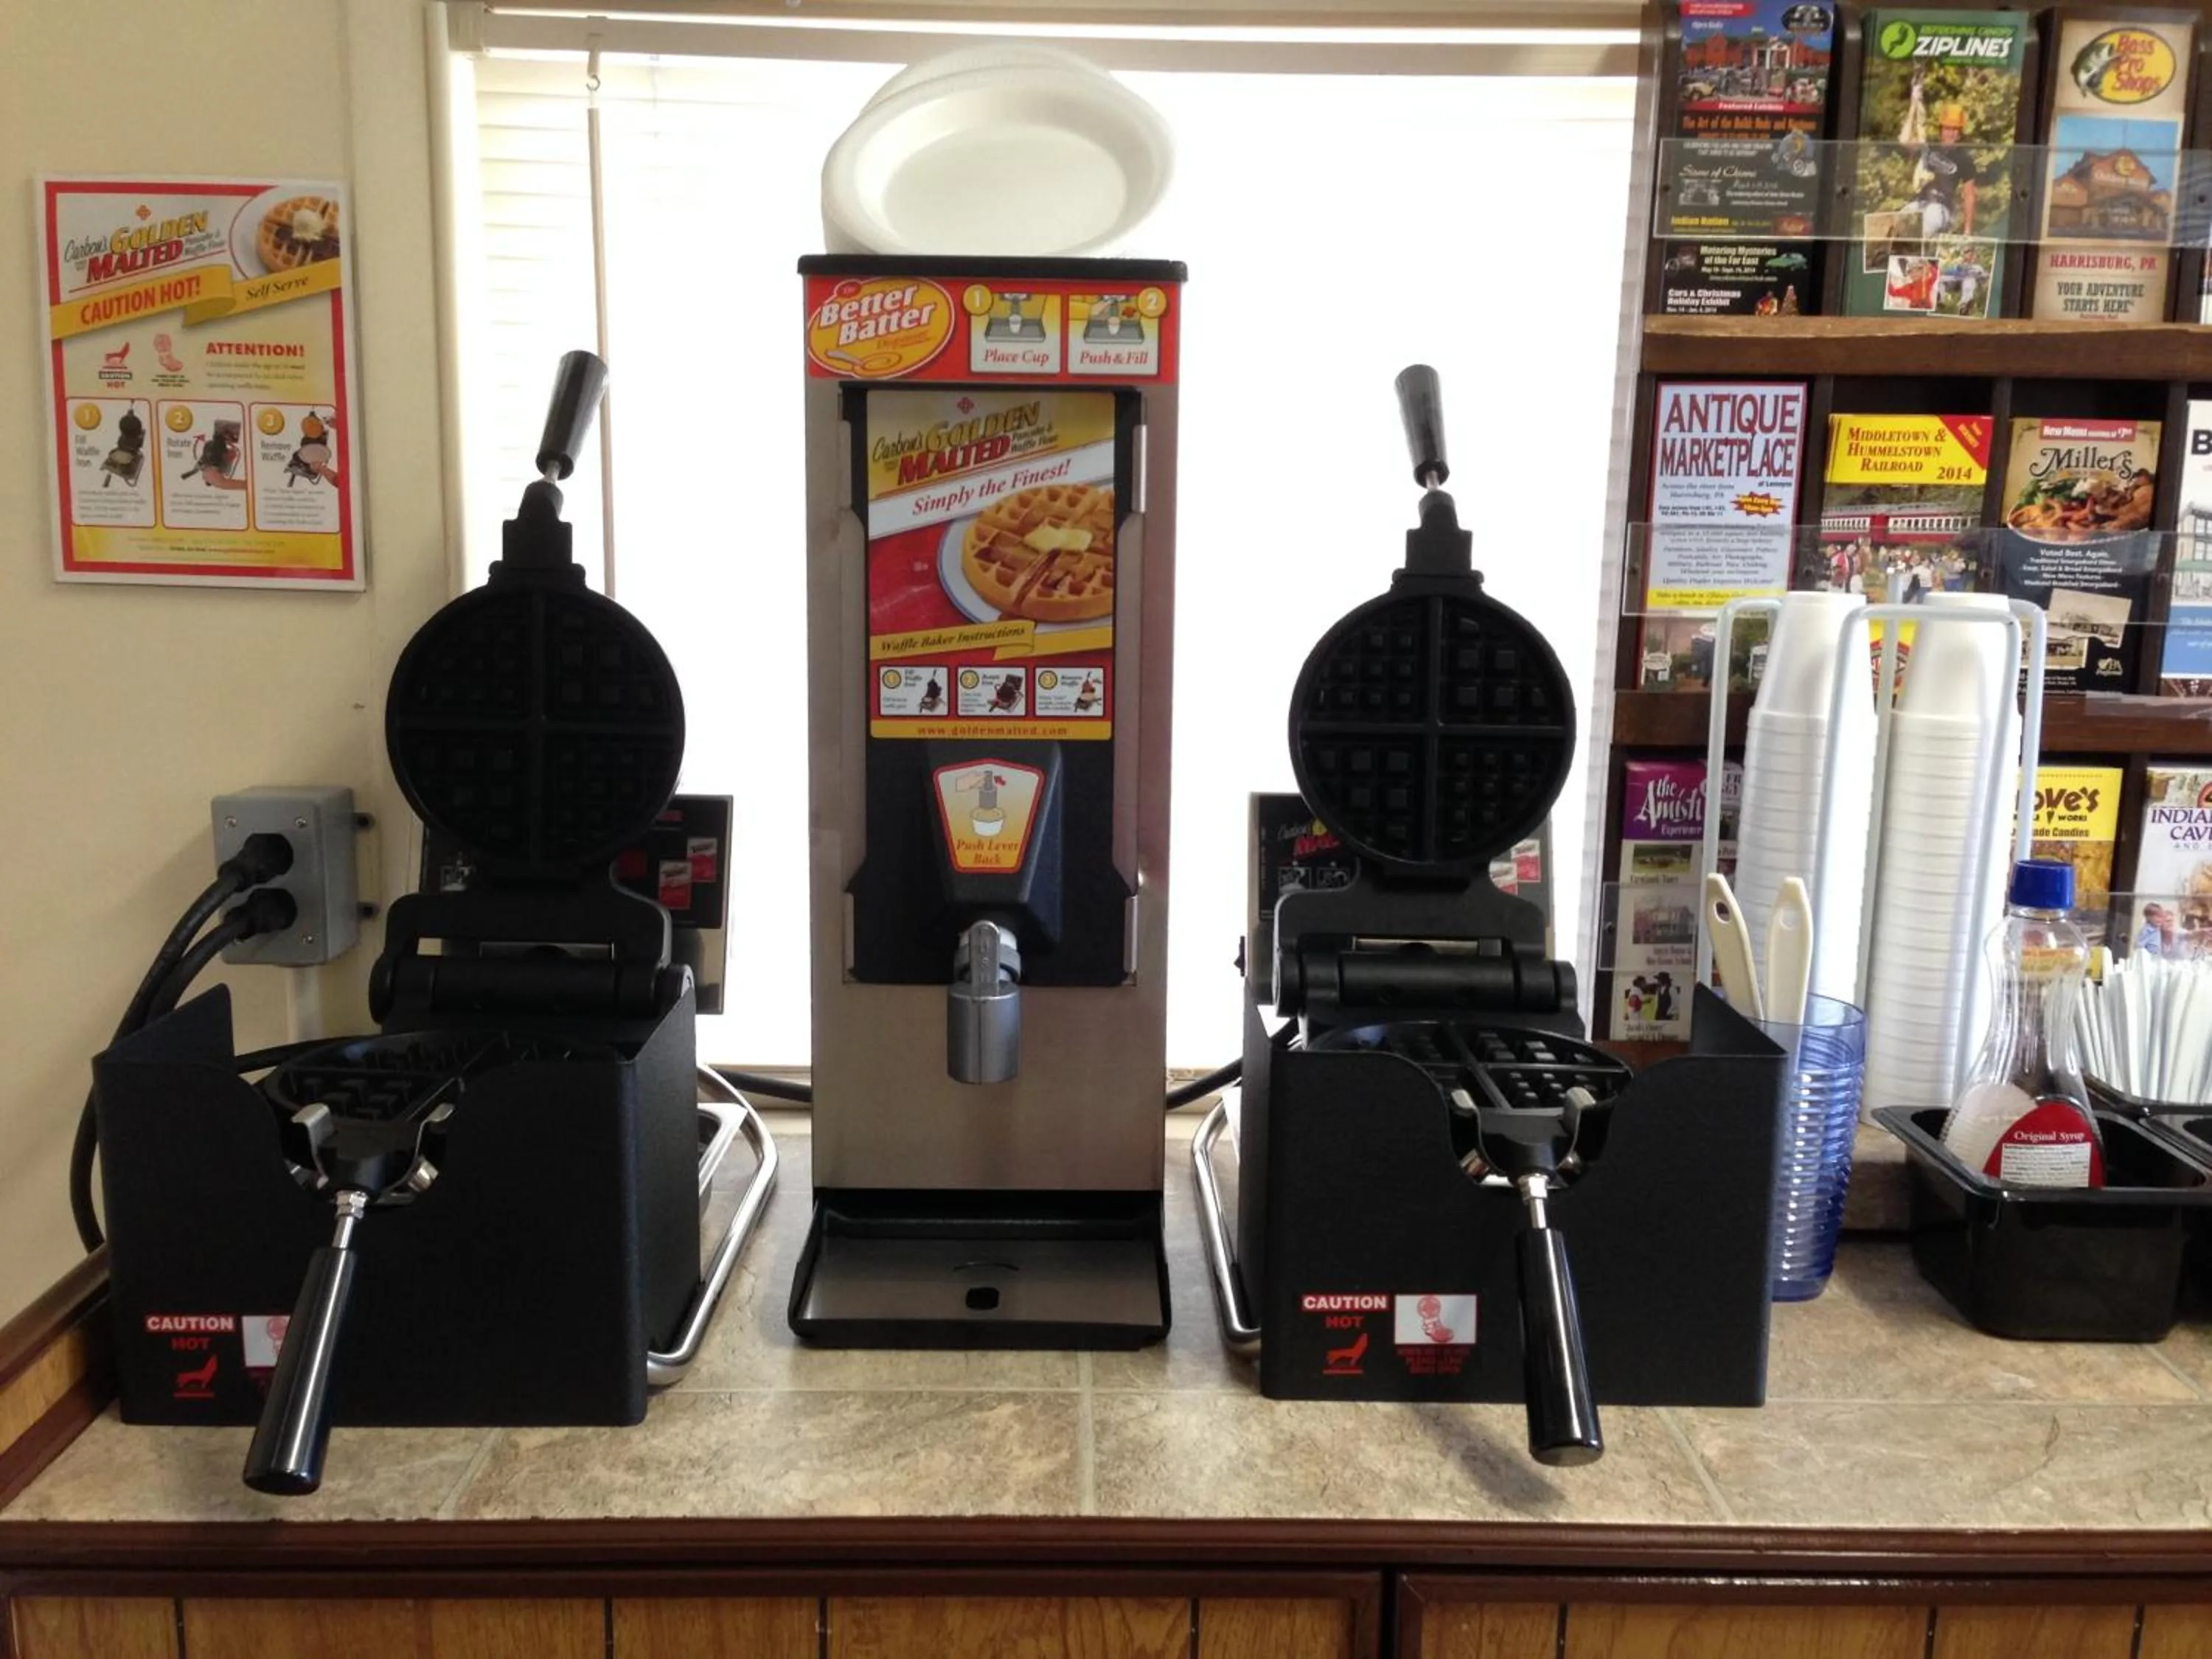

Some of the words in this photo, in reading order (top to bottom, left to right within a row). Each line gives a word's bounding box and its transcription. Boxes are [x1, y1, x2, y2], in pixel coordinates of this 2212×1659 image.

[1913, 35, 2013, 58] ZIPLINES
[2117, 35, 2154, 55] Bass
[2115, 52, 2145, 72] Pro
[2112, 73, 2162, 95] Shops
[110, 210, 209, 254] GOLDEN
[86, 239, 184, 283] MALTED
[2050, 254, 2136, 271] HARRISBURG,
[2140, 257, 2157, 270] PA
[273, 276, 309, 294] Serve
[1668, 288, 1688, 296] Cars
[1697, 288, 1741, 298] Christmas
[2057, 282, 2083, 296] YOUR
[2087, 282, 2145, 297] ADVENTURE
[80, 286, 156, 325] CAUTION
[160, 275, 201, 303] HOT!
[973, 288, 982, 308] 1
[1148, 293, 1158, 310] 2
[2063, 298, 2099, 312] STARTS
[819, 284, 919, 329] Better
[838, 303, 936, 347] Batter
[206, 342, 305, 358] ATTENTION!
[984, 348, 1018, 363] Place
[1022, 349, 1049, 366] Cup
[1079, 349, 1113, 364] Push
[1125, 350, 1149, 365] Fill
[106, 381, 125, 389] HOT
[1663, 393, 1800, 435] ANTIQUE
[924, 401, 1040, 453] GOLDEN
[1848, 426, 1930, 442] MIDDLETOWN
[1934, 428, 1947, 442] &
[2043, 425, 2062, 436] New
[2063, 425, 2087, 437] Menu
[1847, 442, 1943, 456] HUMMELSTOWN
[897, 436, 1011, 486] MALTED
[1660, 437, 1796, 478] MARKETPLACE
[1860, 458, 1924, 472] RAILROAD
[1936, 466, 1973, 480] 2014
[912, 487, 975, 516] Simply
[978, 479, 1007, 498] the
[1011, 458, 1072, 490] Finest!
[2039, 548, 2063, 557] Voted
[880, 638, 919, 653] Waffle
[921, 634, 956, 648] Baker
[958, 627, 1026, 642] Instructions
[917, 726, 1068, 737] www.goldenmalted.com
[1656, 773, 1678, 798] the
[1632, 779, 1702, 830] Amish
[2151, 809, 2212, 824] INDIA
[2052, 827, 2090, 838] Candies
[957, 838, 985, 850] Push
[987, 839, 1018, 850] Lever
[973, 852, 1001, 864] Back
[2014, 1130, 2057, 1143] Original
[2059, 1132, 2086, 1142] Syrup
[1303, 1295, 1388, 1310] CAUTION
[147, 1315, 234, 1331] CAUTION
[1325, 1315, 1363, 1329] HOT
[171, 1337, 212, 1351] HOT
